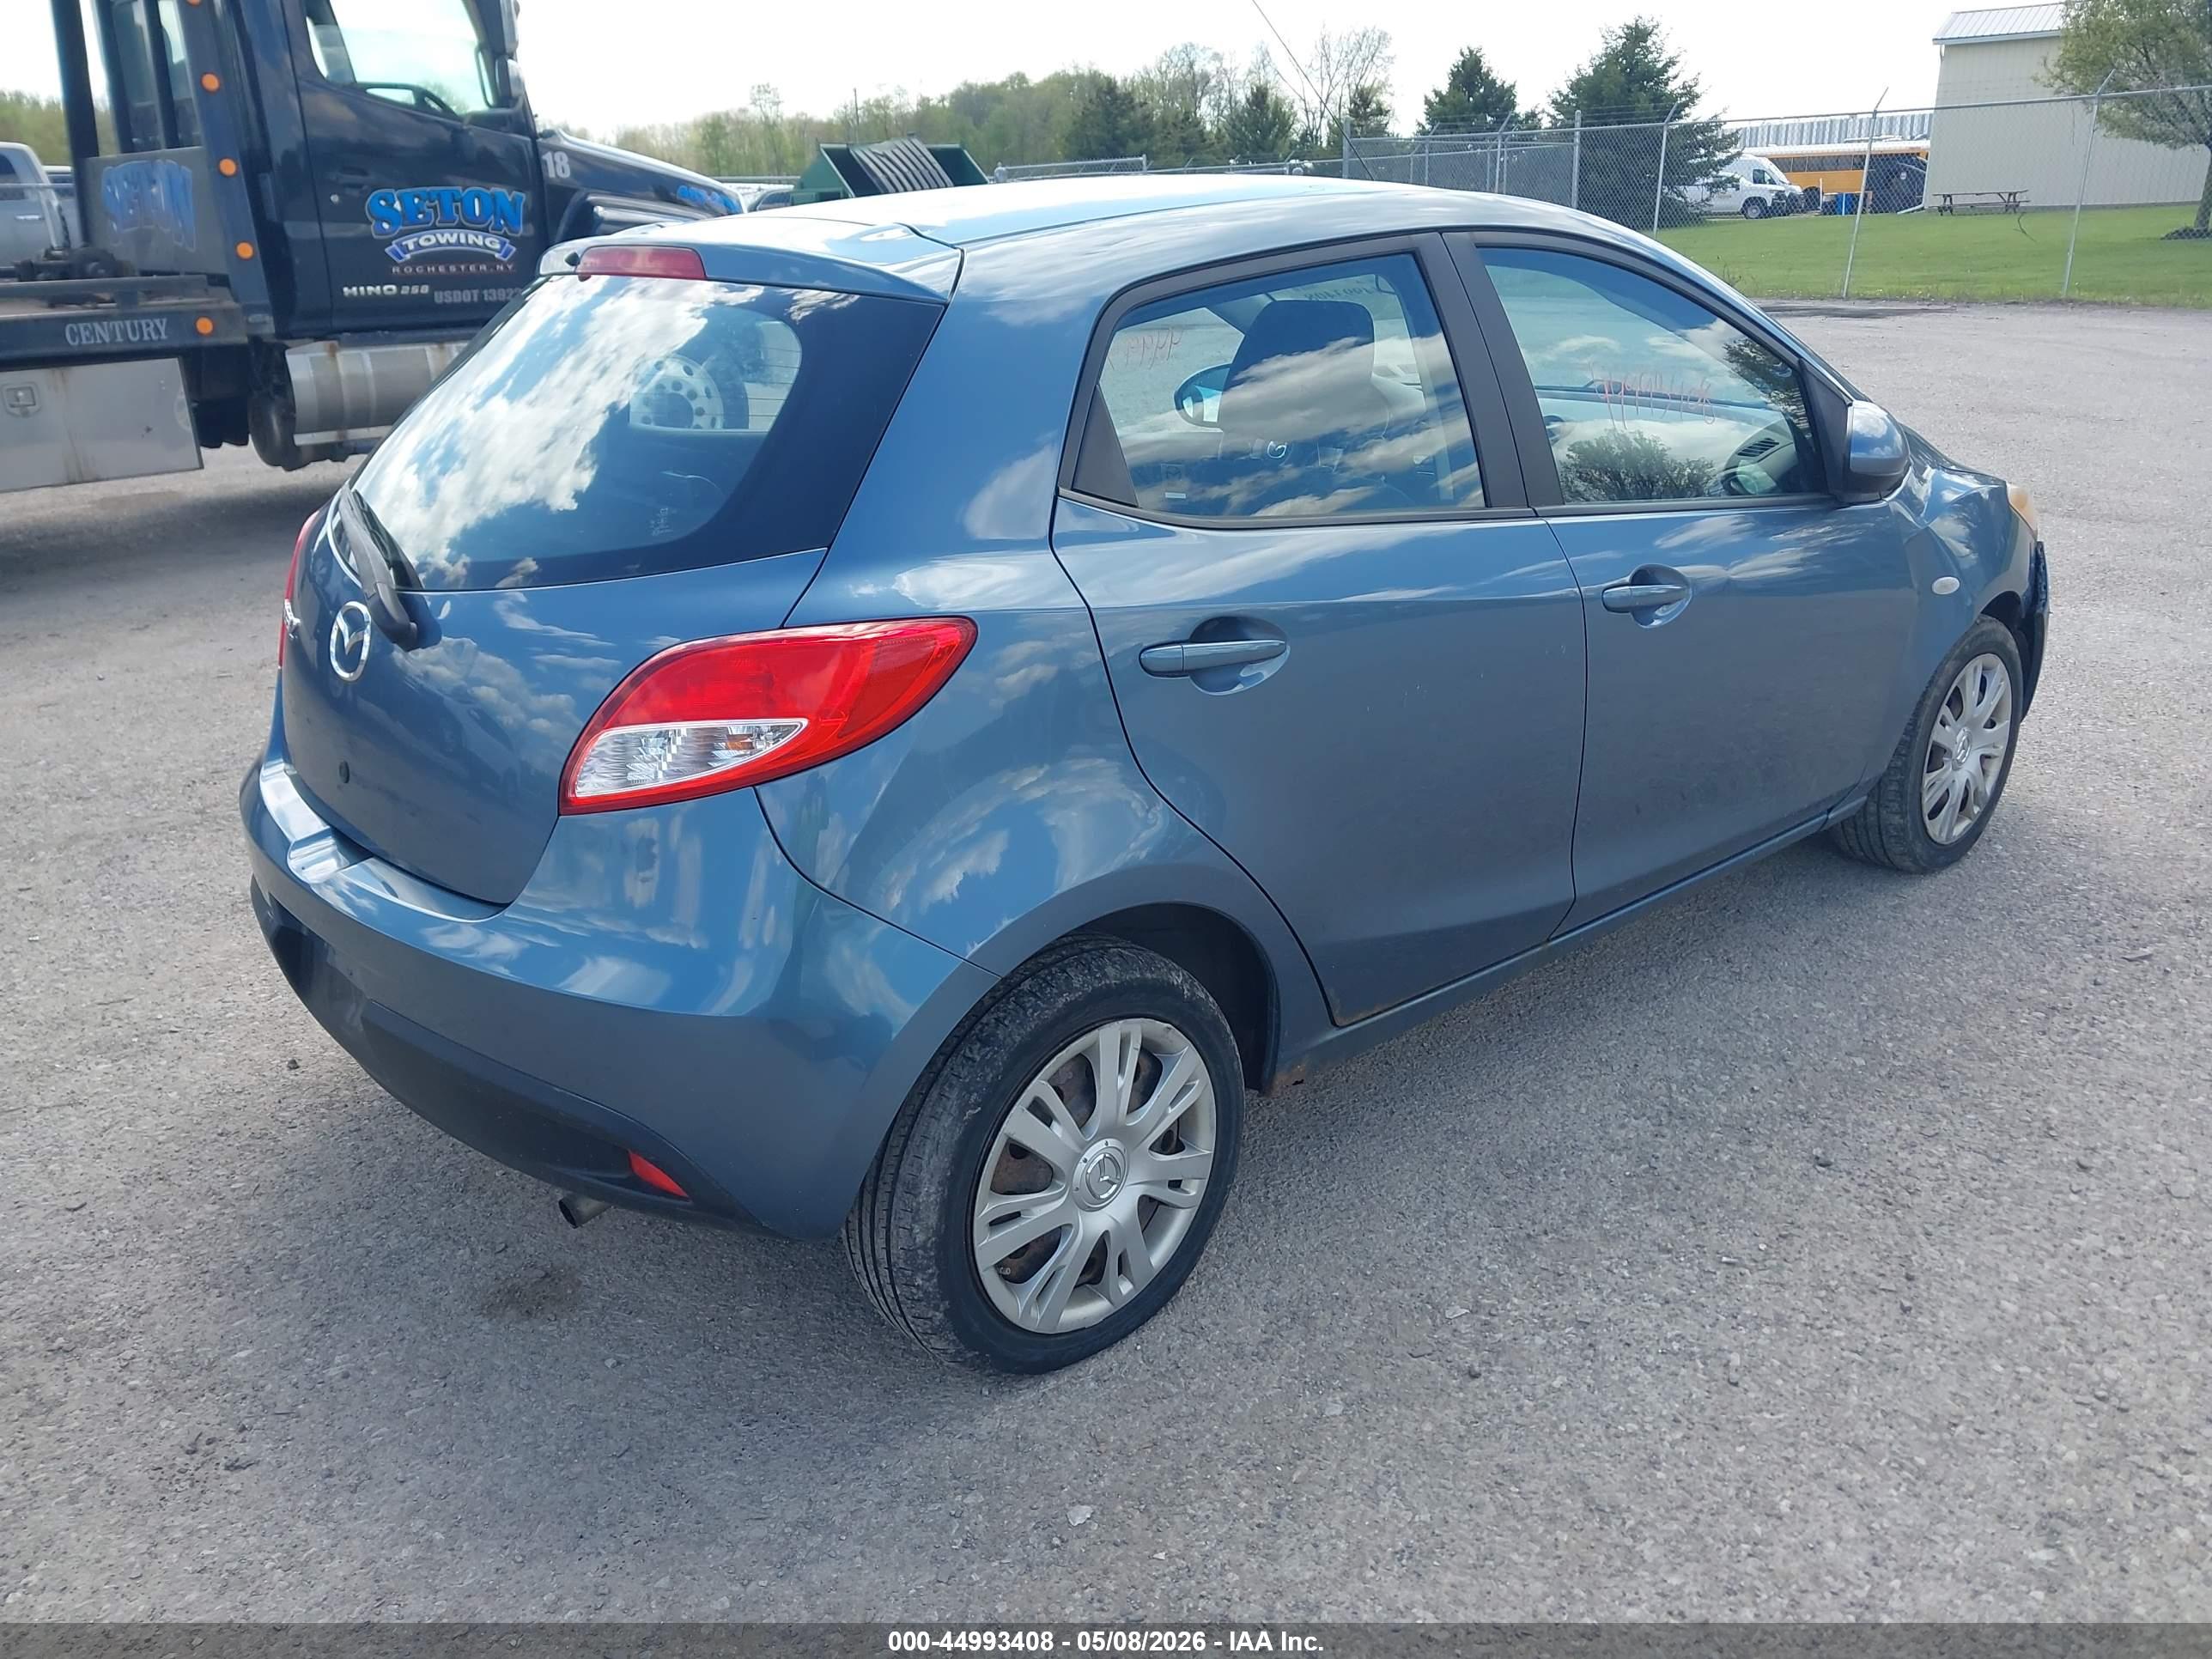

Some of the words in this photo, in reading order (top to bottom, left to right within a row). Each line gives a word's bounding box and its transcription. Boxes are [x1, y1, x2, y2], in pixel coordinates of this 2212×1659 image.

[542, 151, 571, 179] 18
[366, 185, 526, 238] SETON
[402, 232, 501, 252] TOWING
[343, 284, 397, 297] HINO
[434, 289, 479, 304] USDOT
[64, 318, 168, 346] CENTURY
